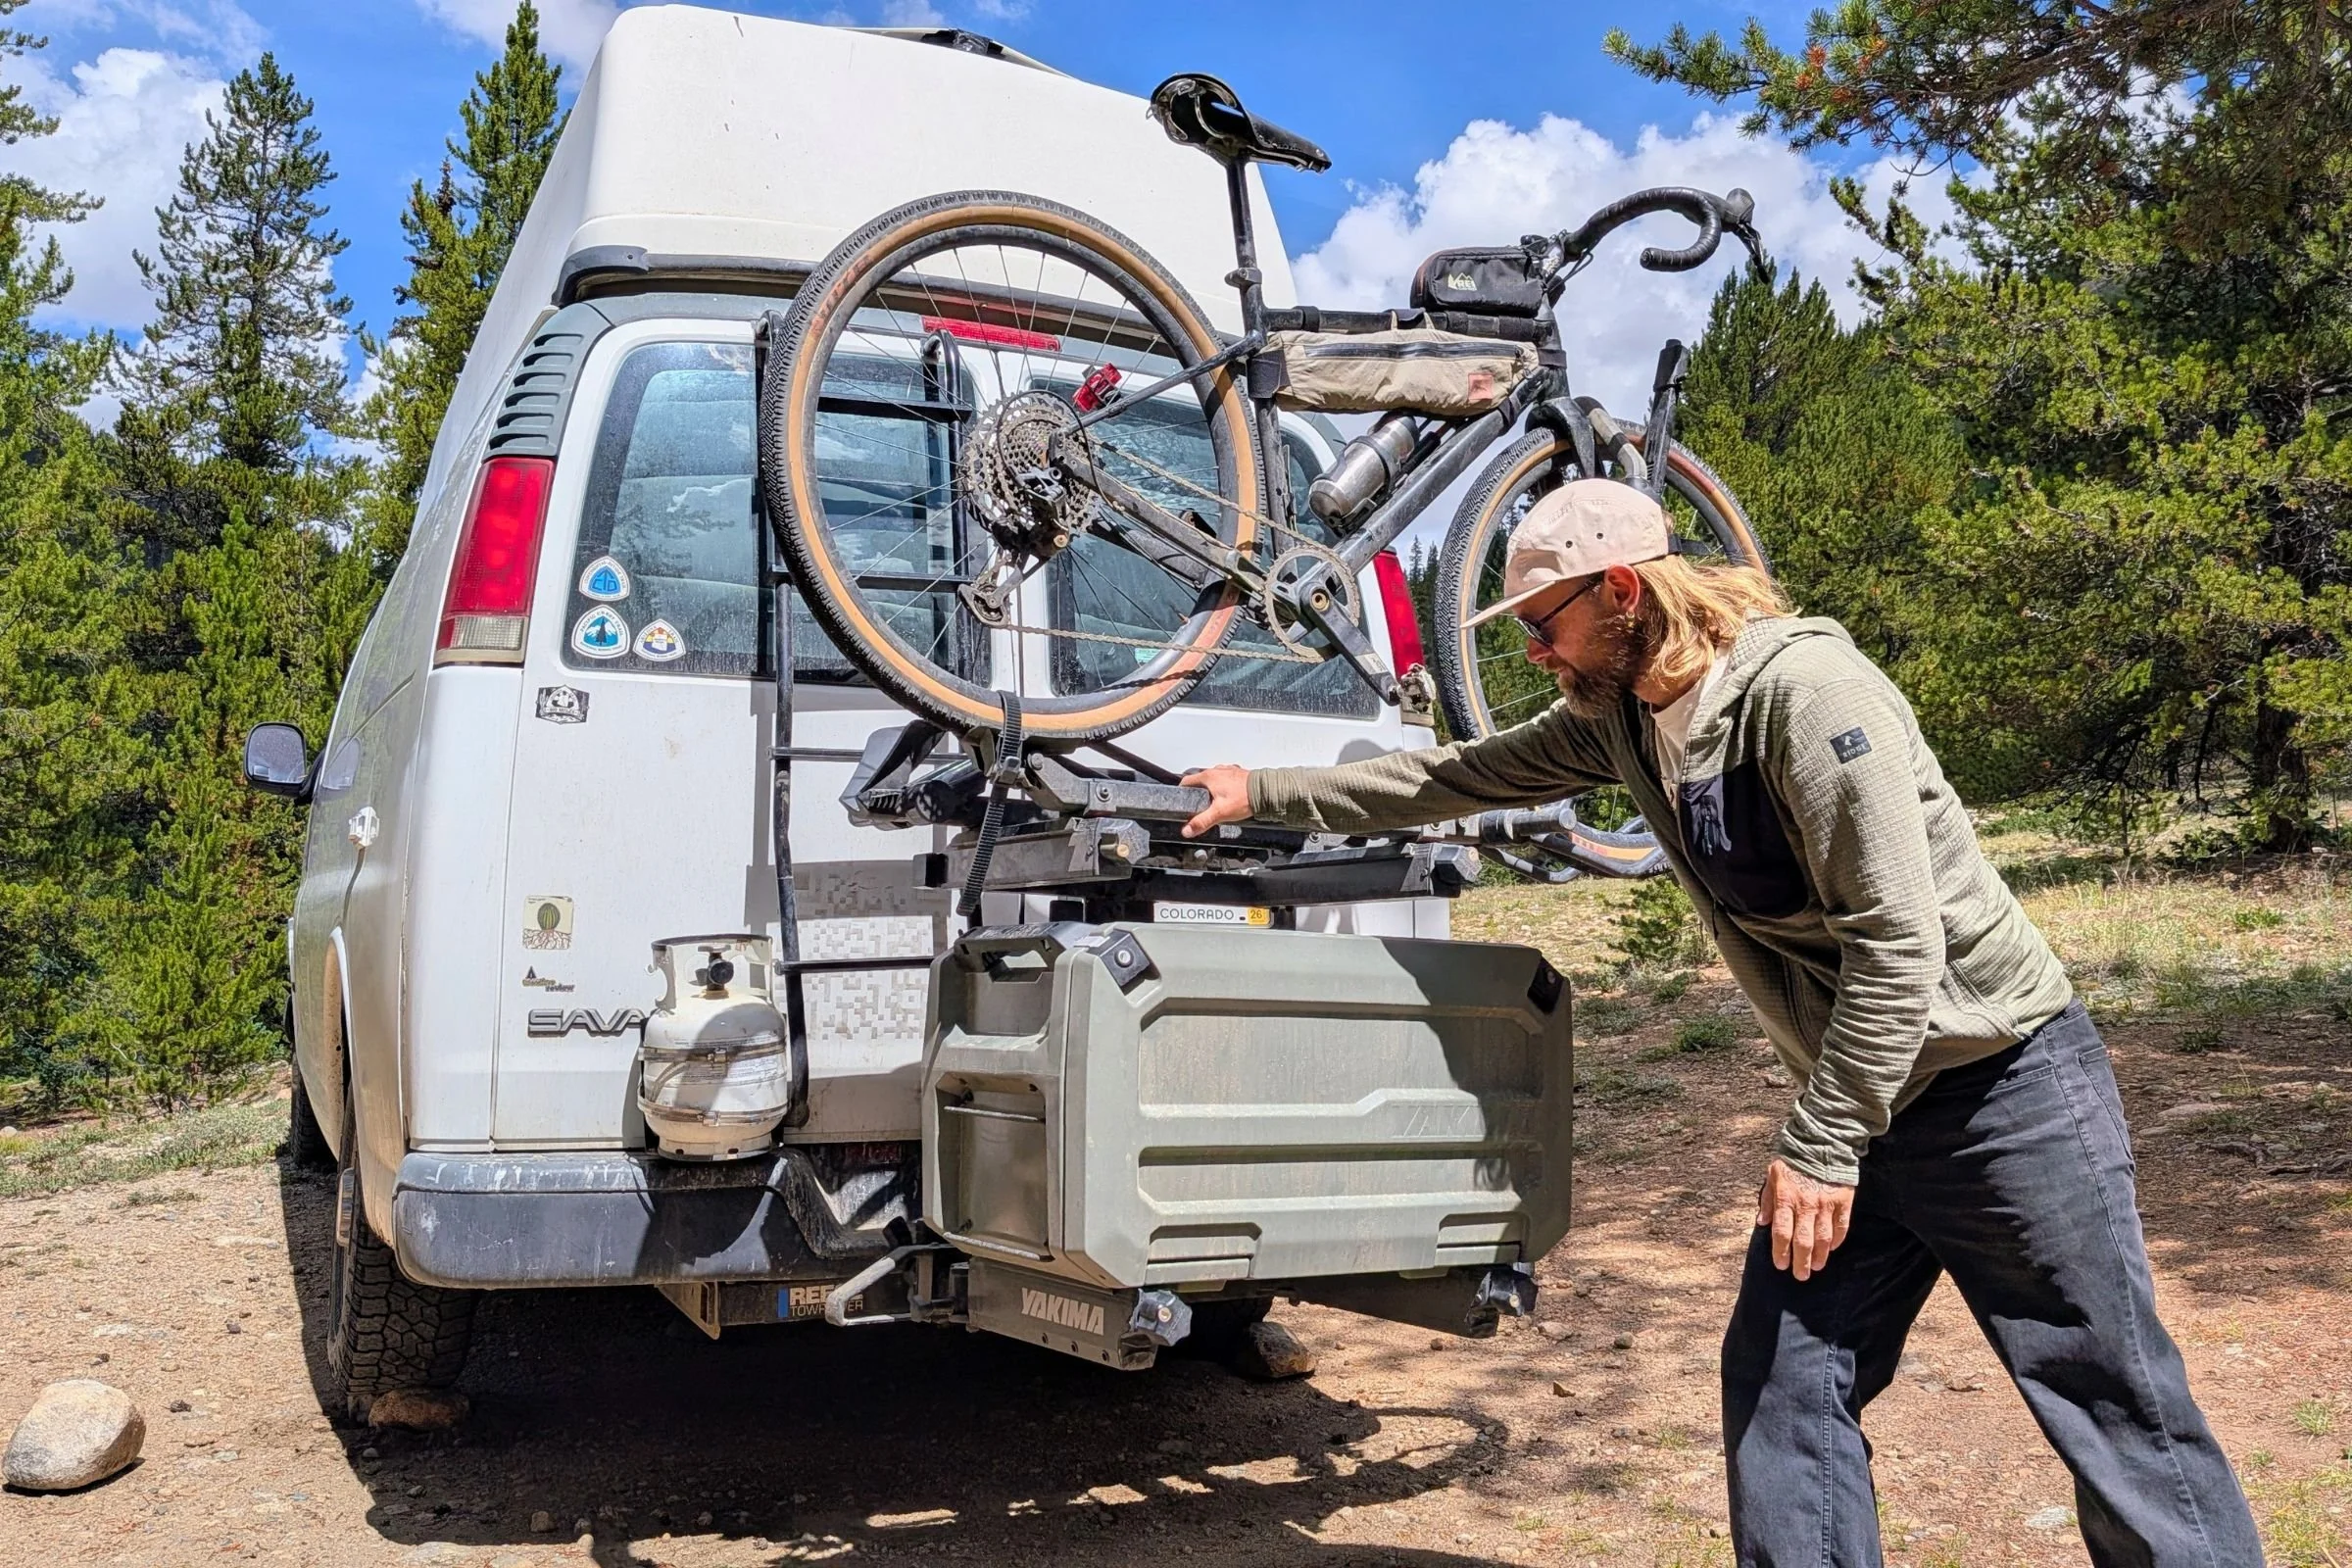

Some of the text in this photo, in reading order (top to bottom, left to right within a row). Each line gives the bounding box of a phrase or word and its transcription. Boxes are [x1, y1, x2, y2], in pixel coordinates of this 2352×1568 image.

[1159, 907, 1235, 920] COLORADO
[1250, 909, 1263, 919] 26
[527, 1008, 648, 1037] SAVA
[1021, 1287, 1104, 1336] YAKIMA
